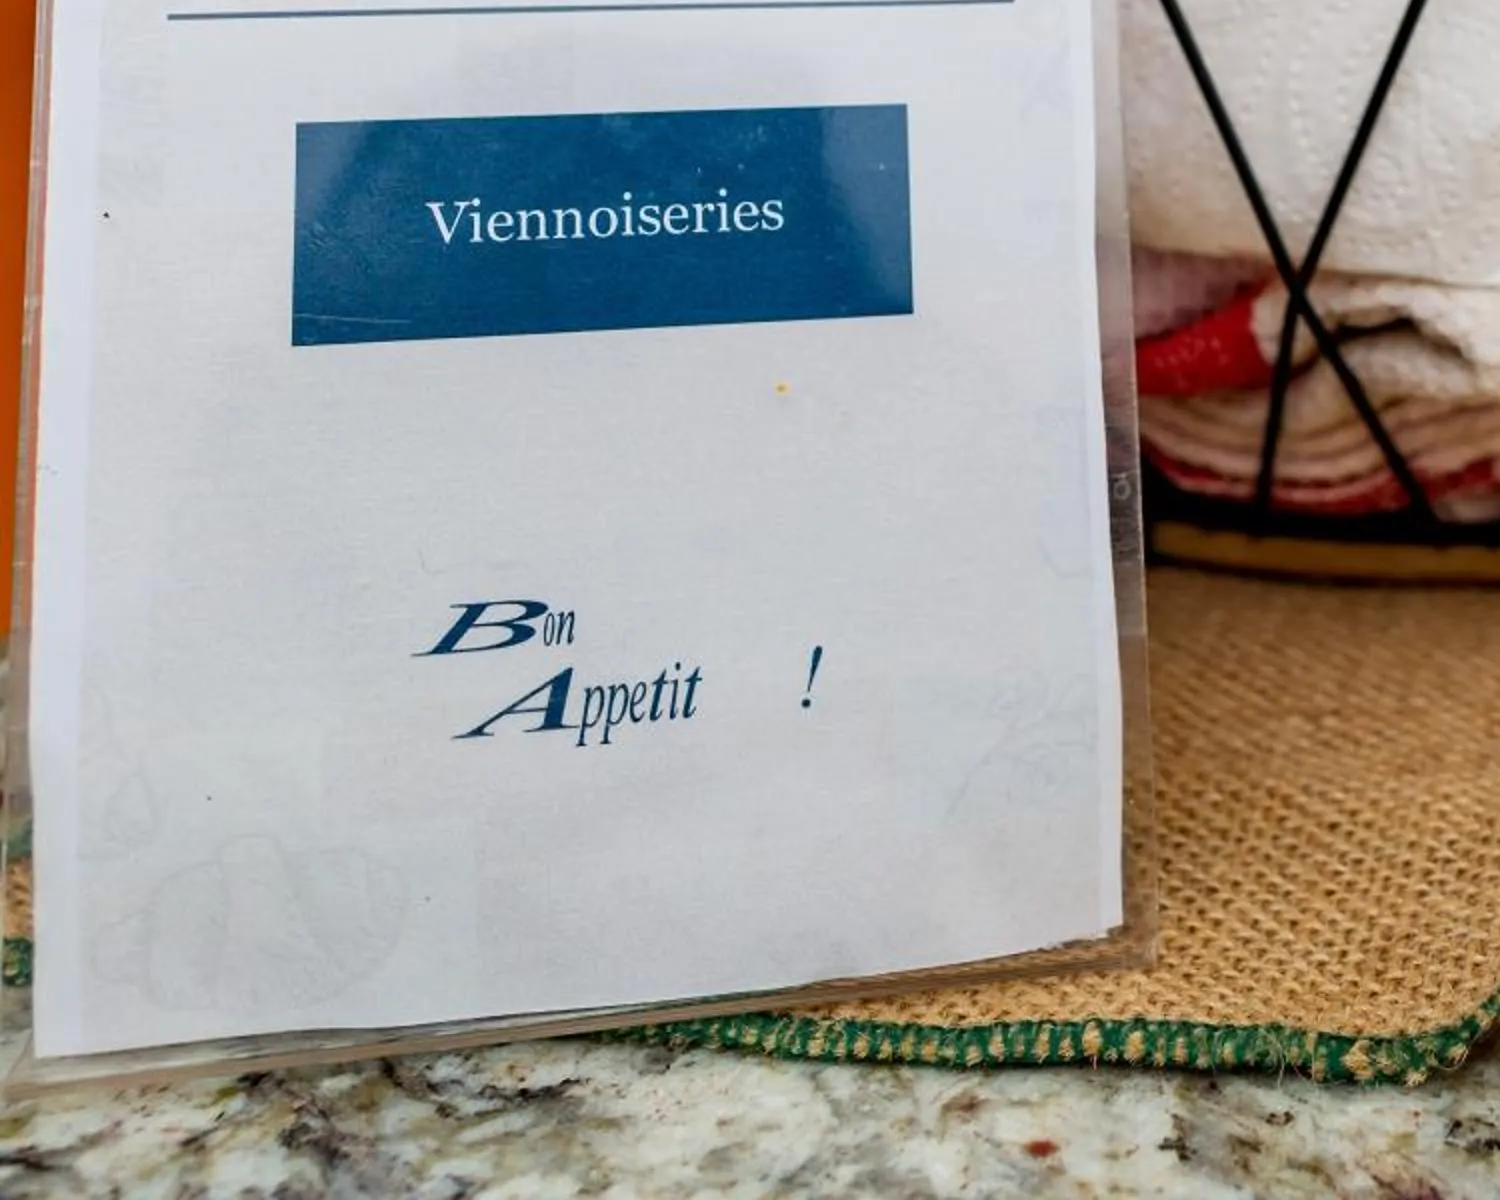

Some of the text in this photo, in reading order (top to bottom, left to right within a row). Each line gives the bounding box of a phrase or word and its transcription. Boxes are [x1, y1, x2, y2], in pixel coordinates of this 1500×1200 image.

[426, 187, 785, 244] Viennoiseries
[410, 600, 575, 657] Bon
[451, 645, 823, 747] Appetit !
